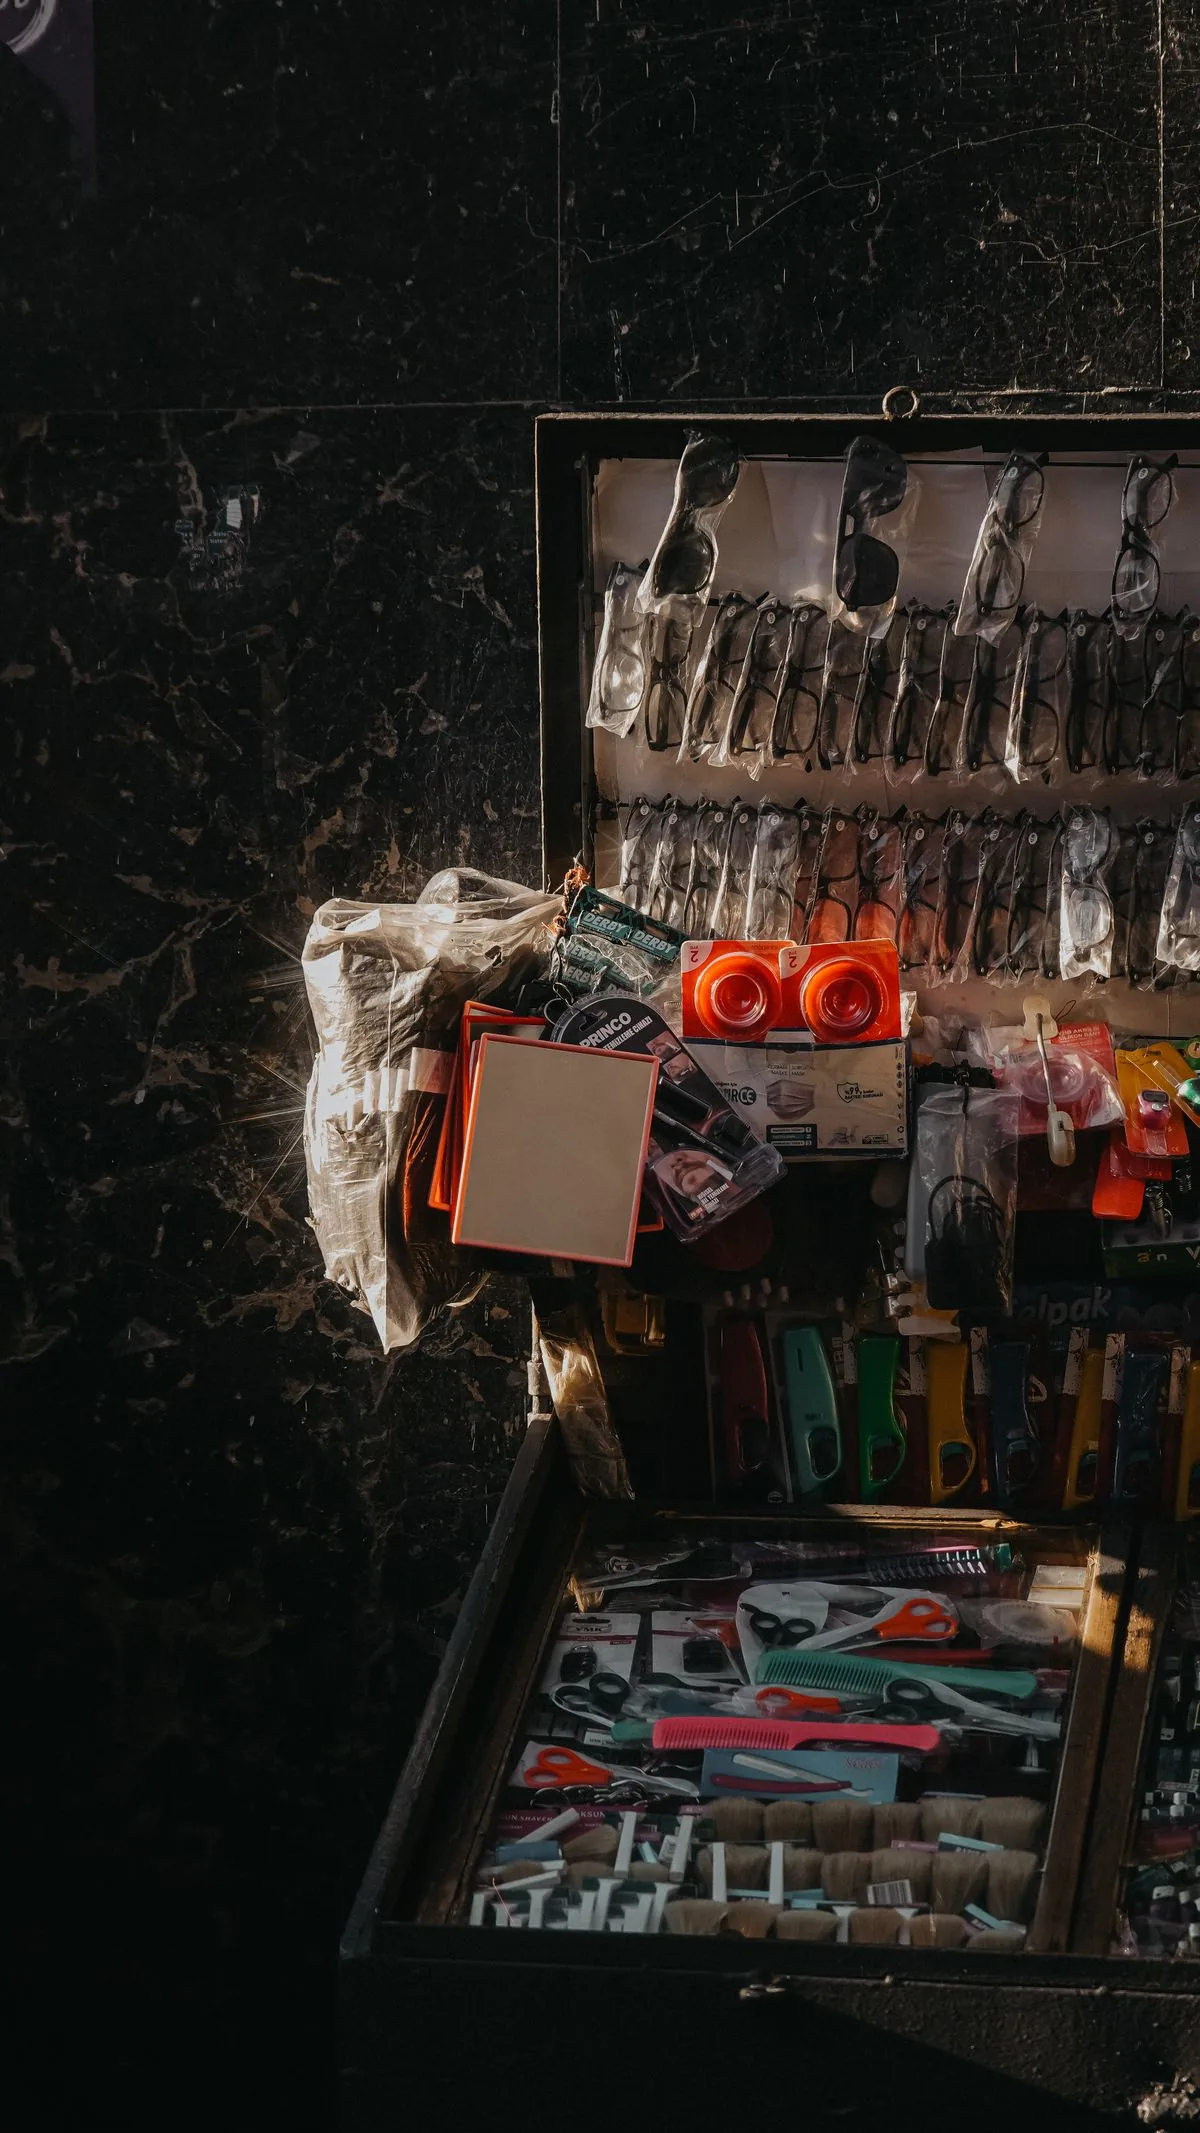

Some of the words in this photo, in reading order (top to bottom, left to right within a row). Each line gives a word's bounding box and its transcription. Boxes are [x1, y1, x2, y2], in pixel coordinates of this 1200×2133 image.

[583, 912, 629, 932] DERBY
[633, 929, 677, 953] DERBY
[690, 950, 699, 963] 2
[789, 956, 798, 968] 2
[579, 1012, 632, 1048] PRINCO
[1014, 1284, 1112, 1330] elpak
